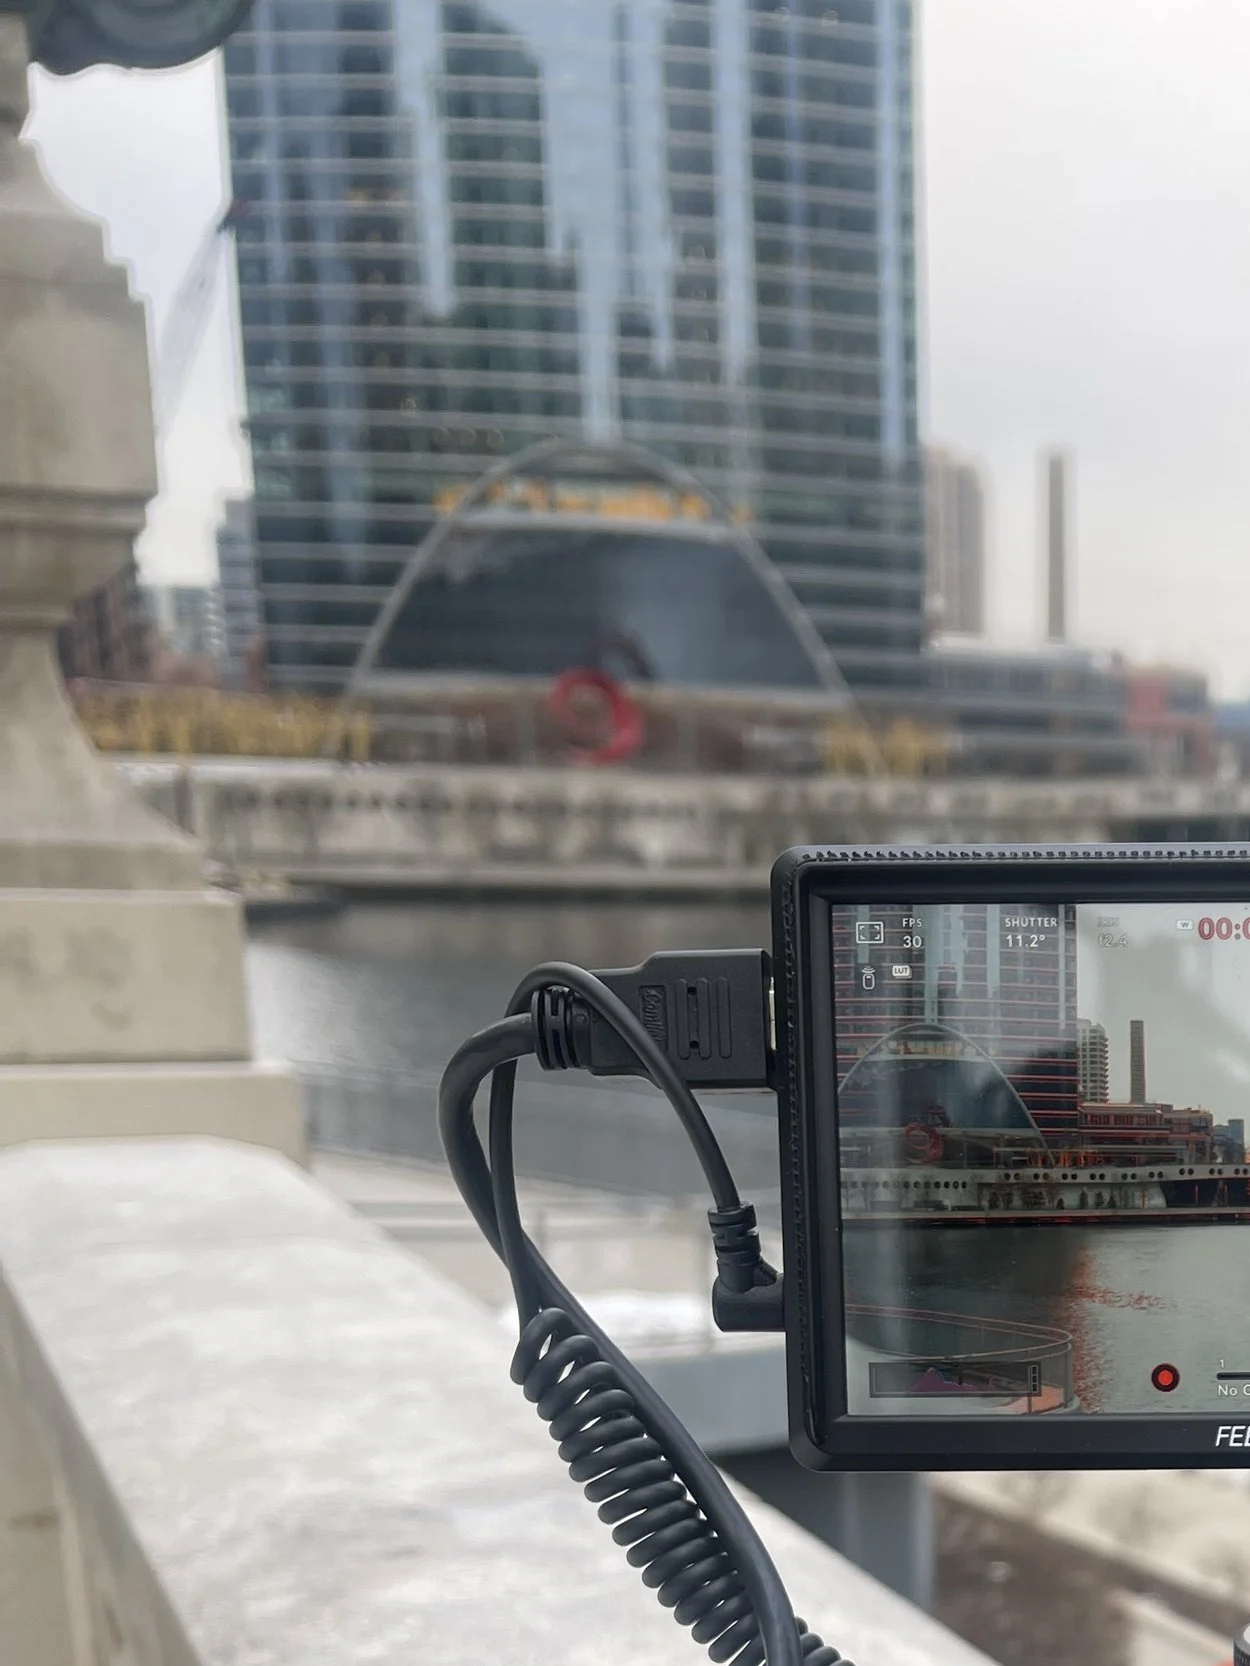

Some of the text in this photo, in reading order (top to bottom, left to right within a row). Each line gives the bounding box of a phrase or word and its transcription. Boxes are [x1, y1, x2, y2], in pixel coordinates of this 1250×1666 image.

[902, 917, 923, 928] FPS
[1005, 917, 1058, 928] SHUTTER
[902, 935, 923, 949] 30
[1006, 934, 1046, 948] 11.2°
[893, 966, 910, 976] LUT
[1219, 1359, 1225, 1368] 1
[1218, 1384, 1237, 1396] No
